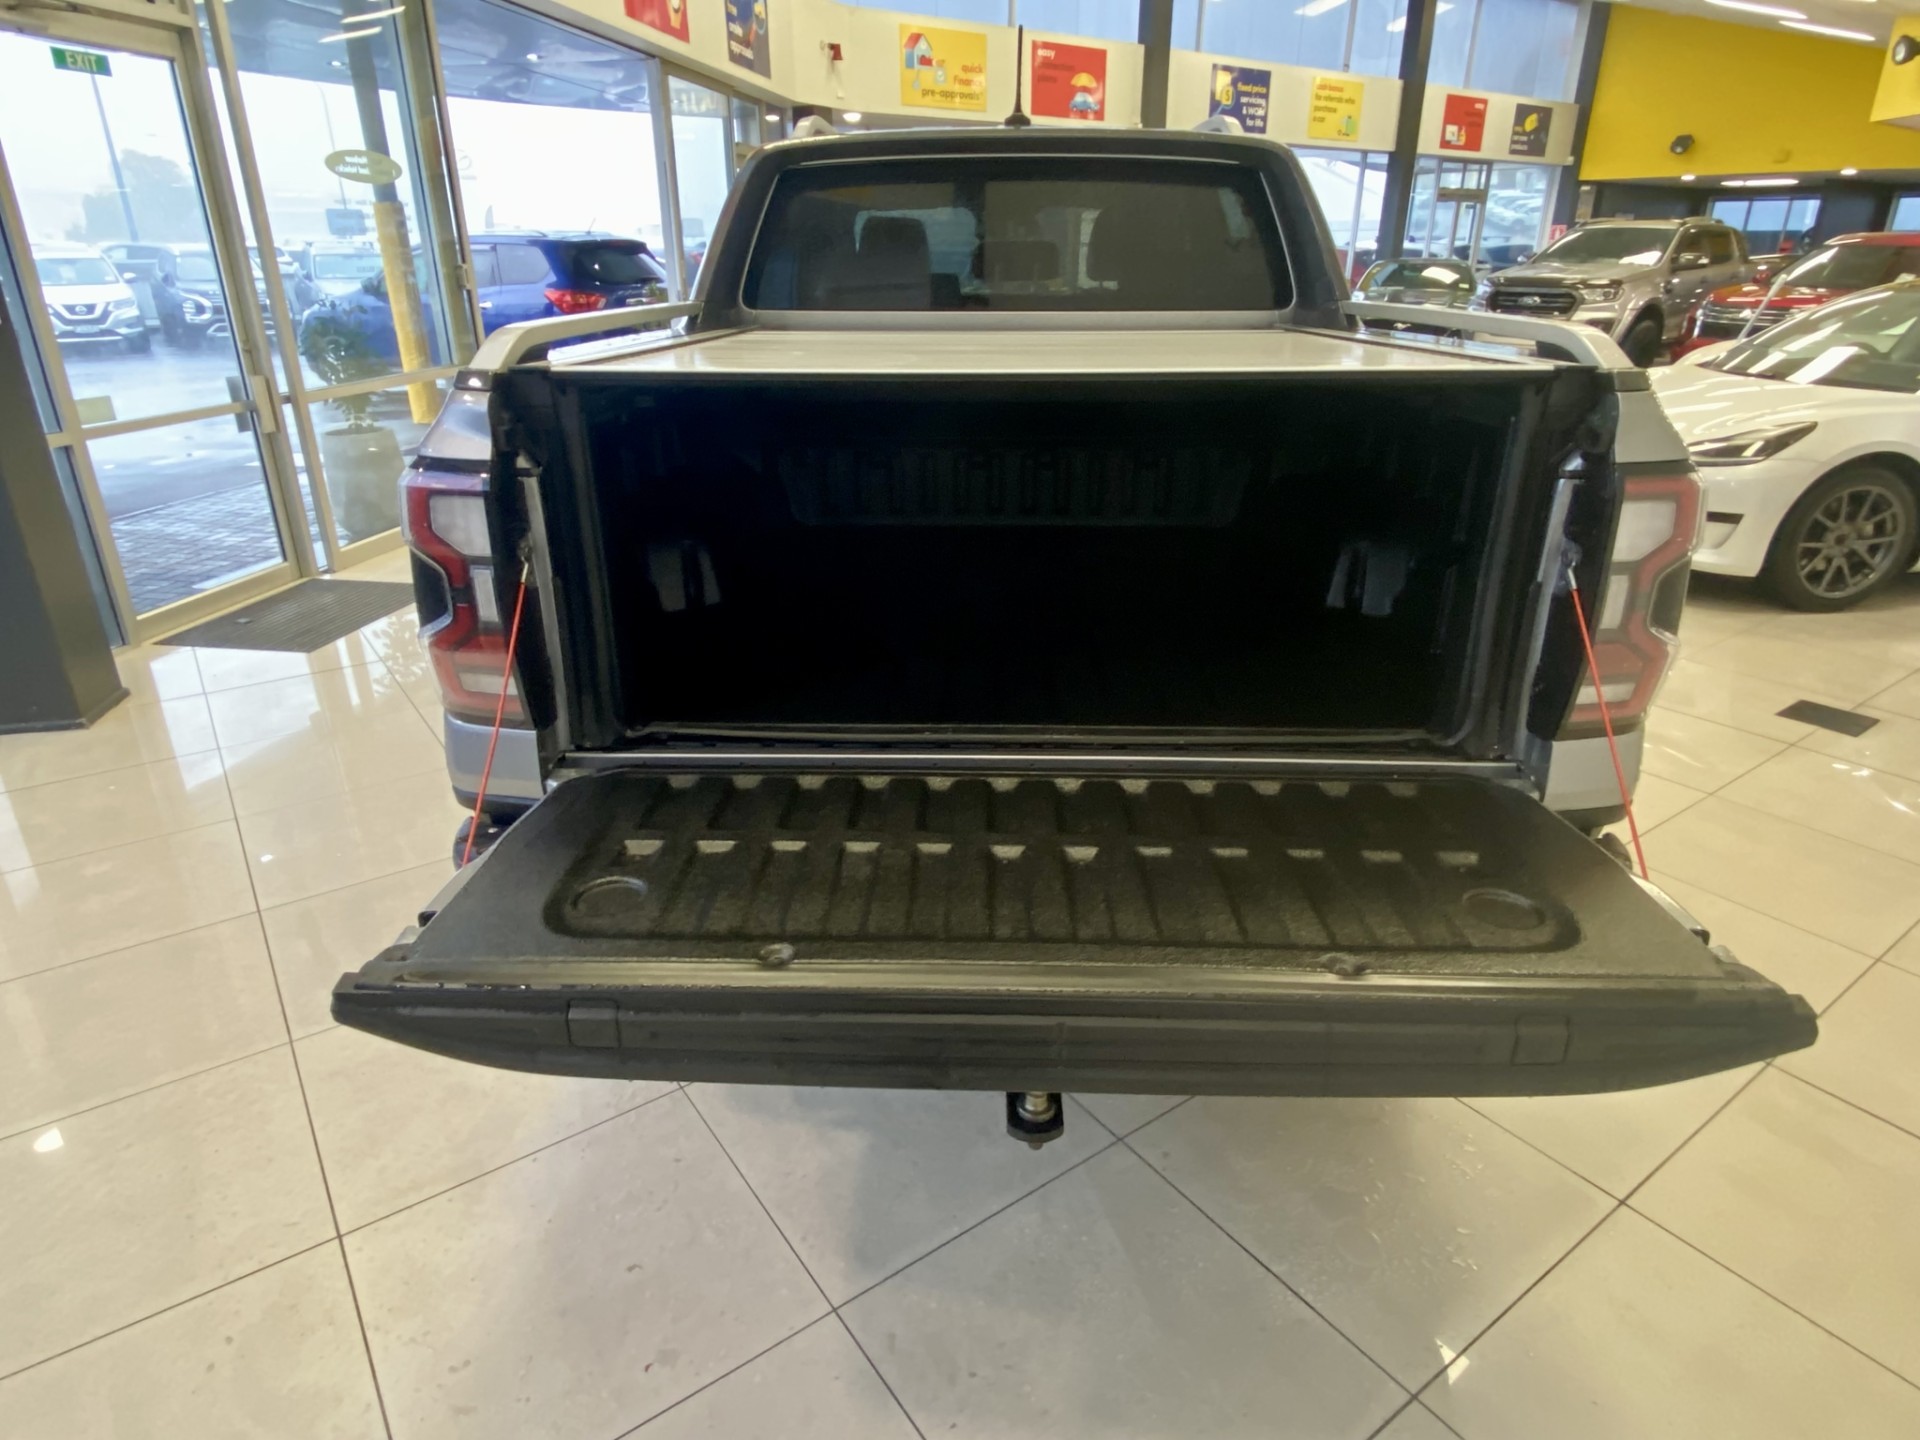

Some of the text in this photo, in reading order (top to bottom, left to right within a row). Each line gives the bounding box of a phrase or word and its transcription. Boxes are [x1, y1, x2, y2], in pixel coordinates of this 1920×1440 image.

[1037, 48, 1056, 60] easy
[65, 50, 97, 73] EXIT
[961, 63, 984, 74] quick
[1240, 96, 1266, 106] servicing
[1246, 117, 1254, 126] for
